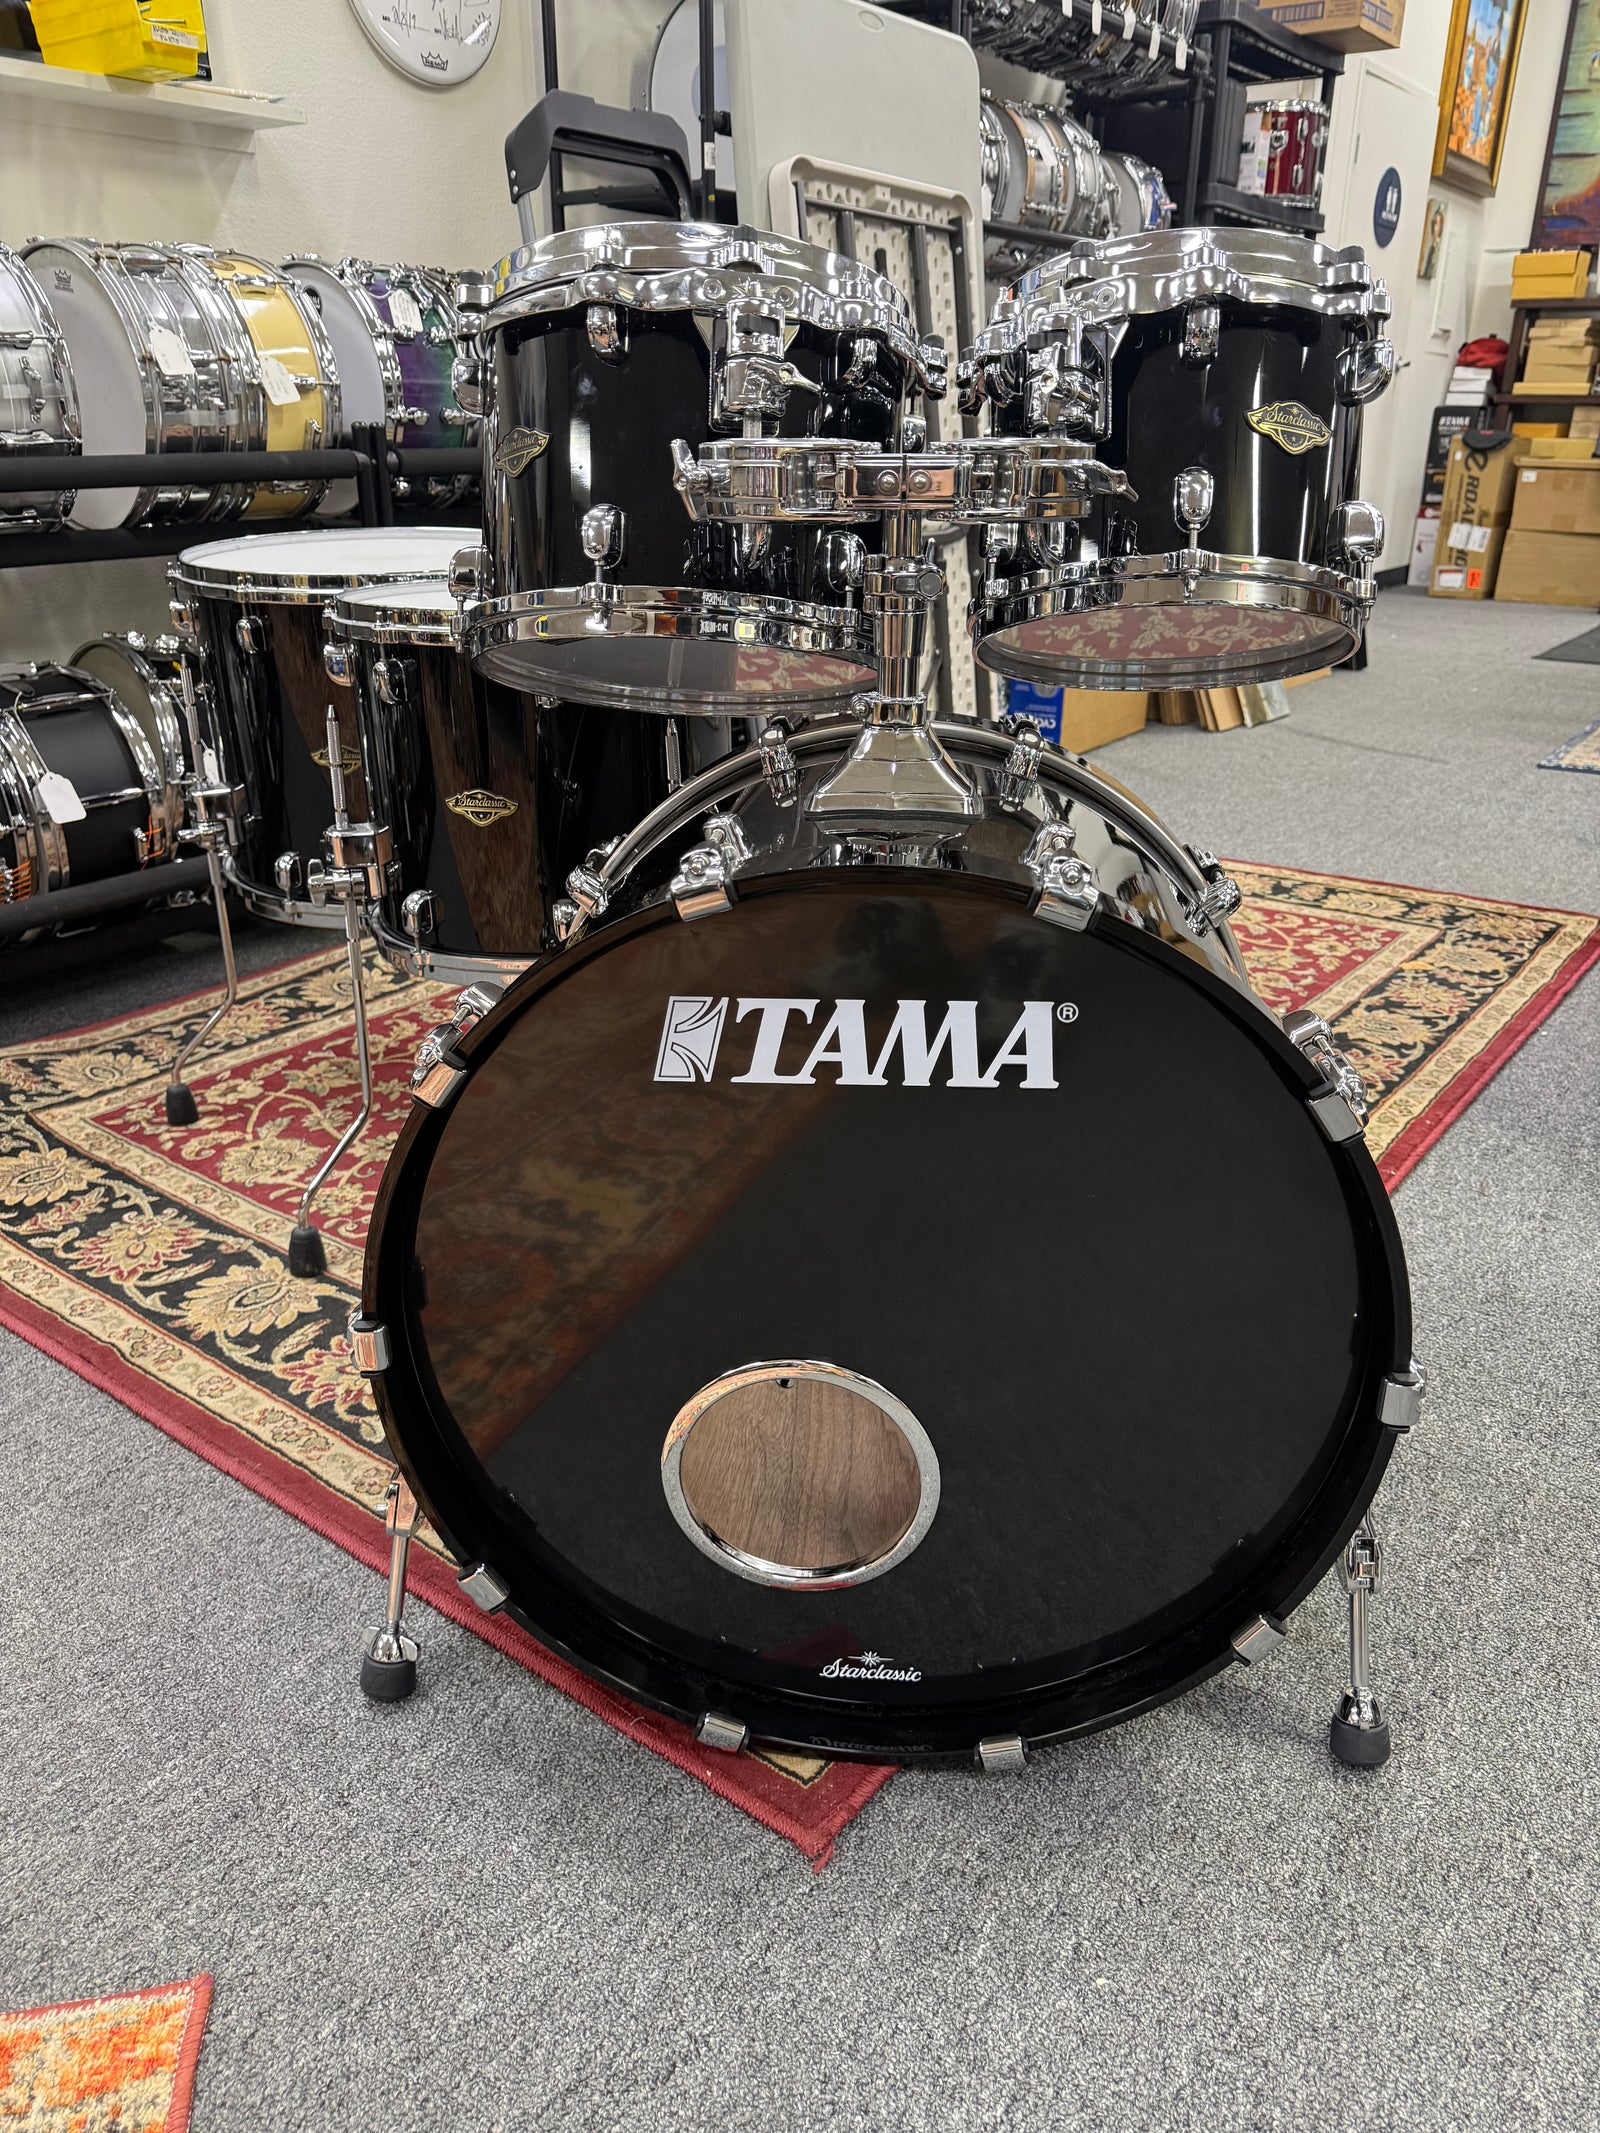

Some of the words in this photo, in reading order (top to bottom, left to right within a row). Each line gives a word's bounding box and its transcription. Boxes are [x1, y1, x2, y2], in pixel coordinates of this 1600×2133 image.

[1265, 405, 1321, 432] Starclassic
[458, 794, 506, 807] Starclassic
[730, 997, 1060, 1089] TAMA
[819, 1658, 922, 1682] Starclassic
